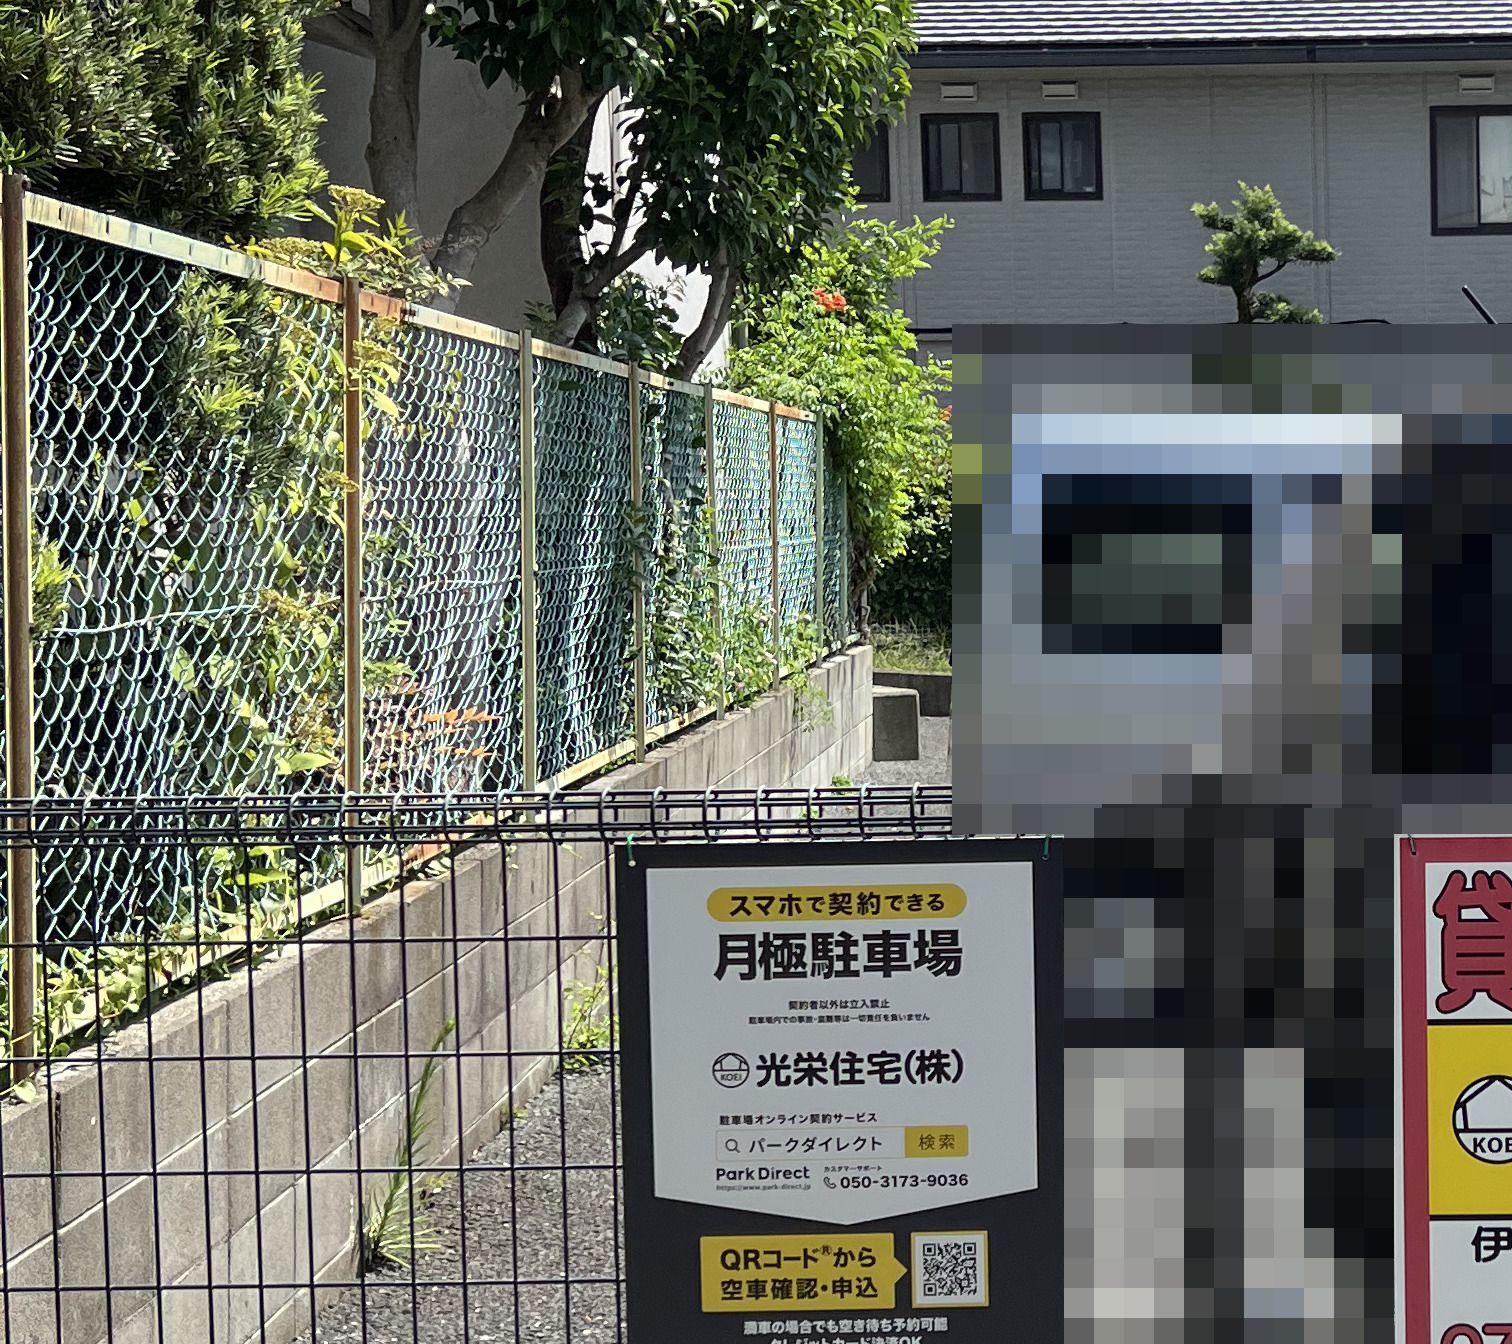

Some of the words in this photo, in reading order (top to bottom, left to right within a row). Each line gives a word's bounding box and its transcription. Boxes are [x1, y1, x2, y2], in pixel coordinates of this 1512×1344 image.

[730, 891, 945, 917] スマホで契約できる
[713, 929, 963, 982] 月極駐車場
[788, 998, 891, 1011] 契約者以外は立入禁止
[755, 1048, 964, 1088] 光栄住宅(株)
[719, 1112, 878, 1126] 駐車場オンライン契約サービス
[748, 1136, 882, 1153] パークダイレクト
[918, 1133, 955, 1151] 検索
[716, 1167, 755, 1181] Park
[758, 1166, 810, 1181] Direct
[823, 1165, 883, 1173] カスタマーサポート
[840, 1173, 969, 1189] 050-3173-9036
[720, 1276, 879, 1301] 空車確認・申込
[743, 1316, 948, 1335] 満車の場合でも空き待ち予約可能
